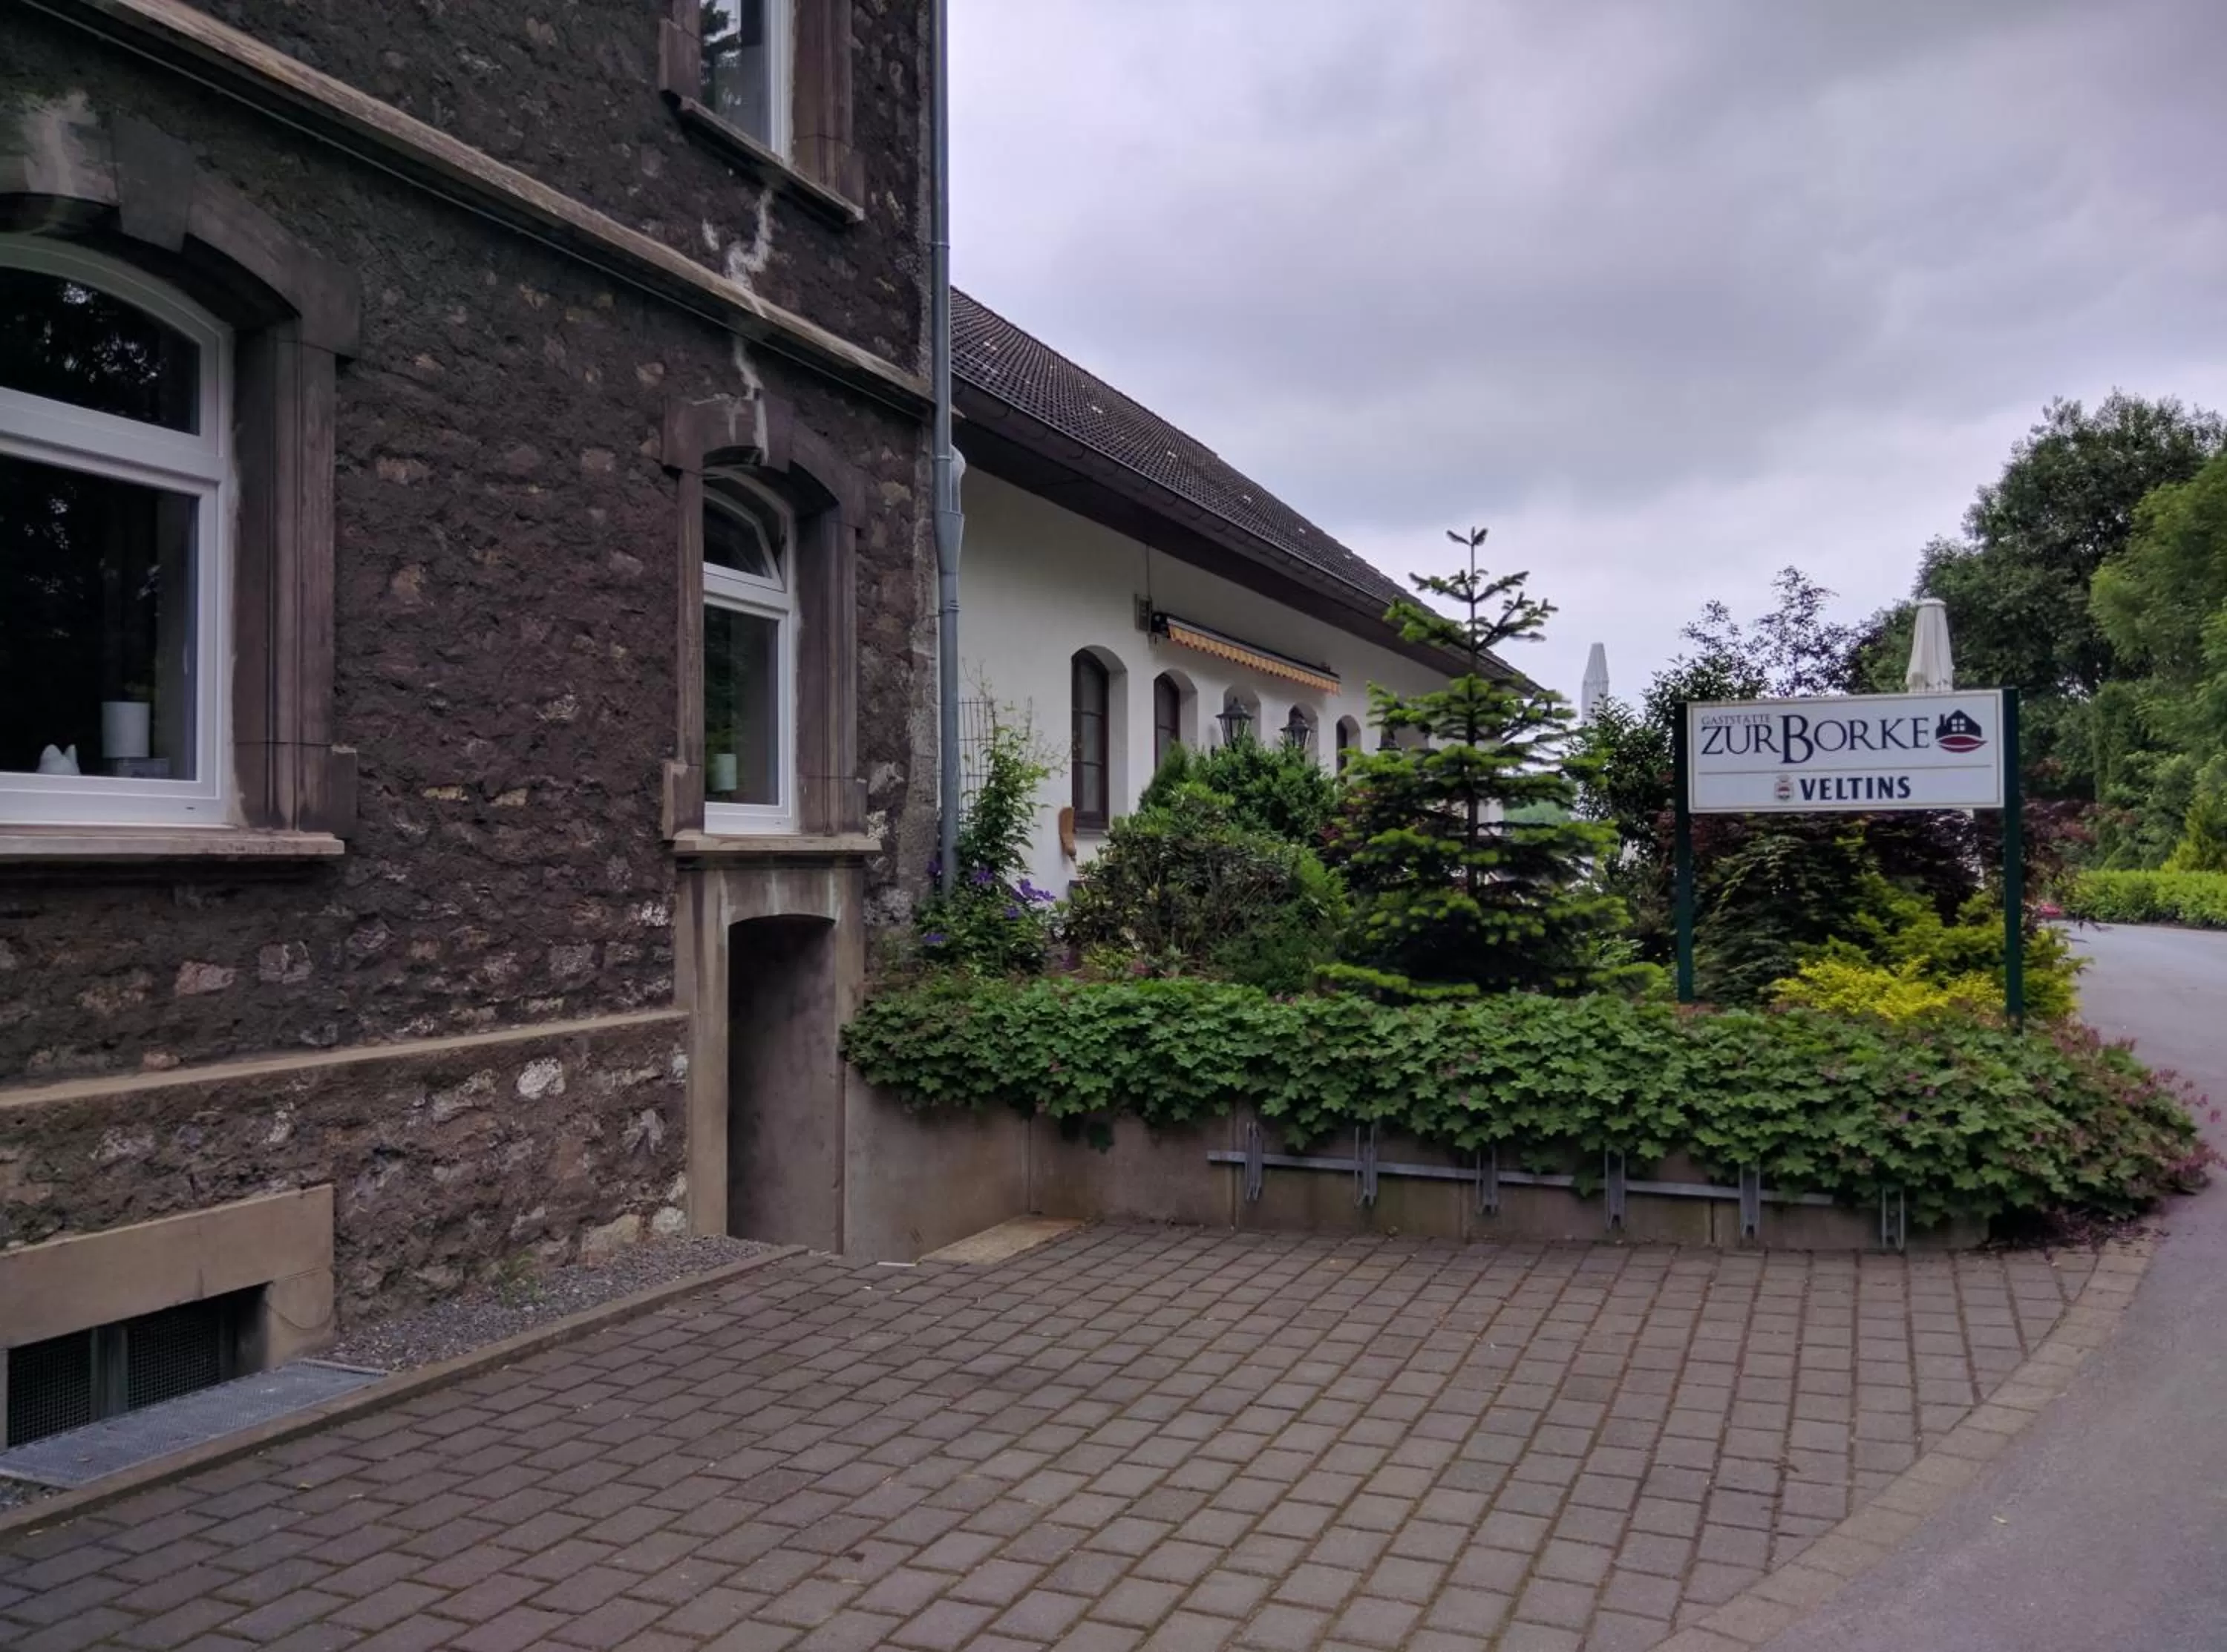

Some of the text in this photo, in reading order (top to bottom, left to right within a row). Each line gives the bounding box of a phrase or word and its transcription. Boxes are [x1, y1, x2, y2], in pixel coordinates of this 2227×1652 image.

[1701, 714, 1930, 764] ZUR BORKE
[1799, 776, 1912, 801] VELTINS
